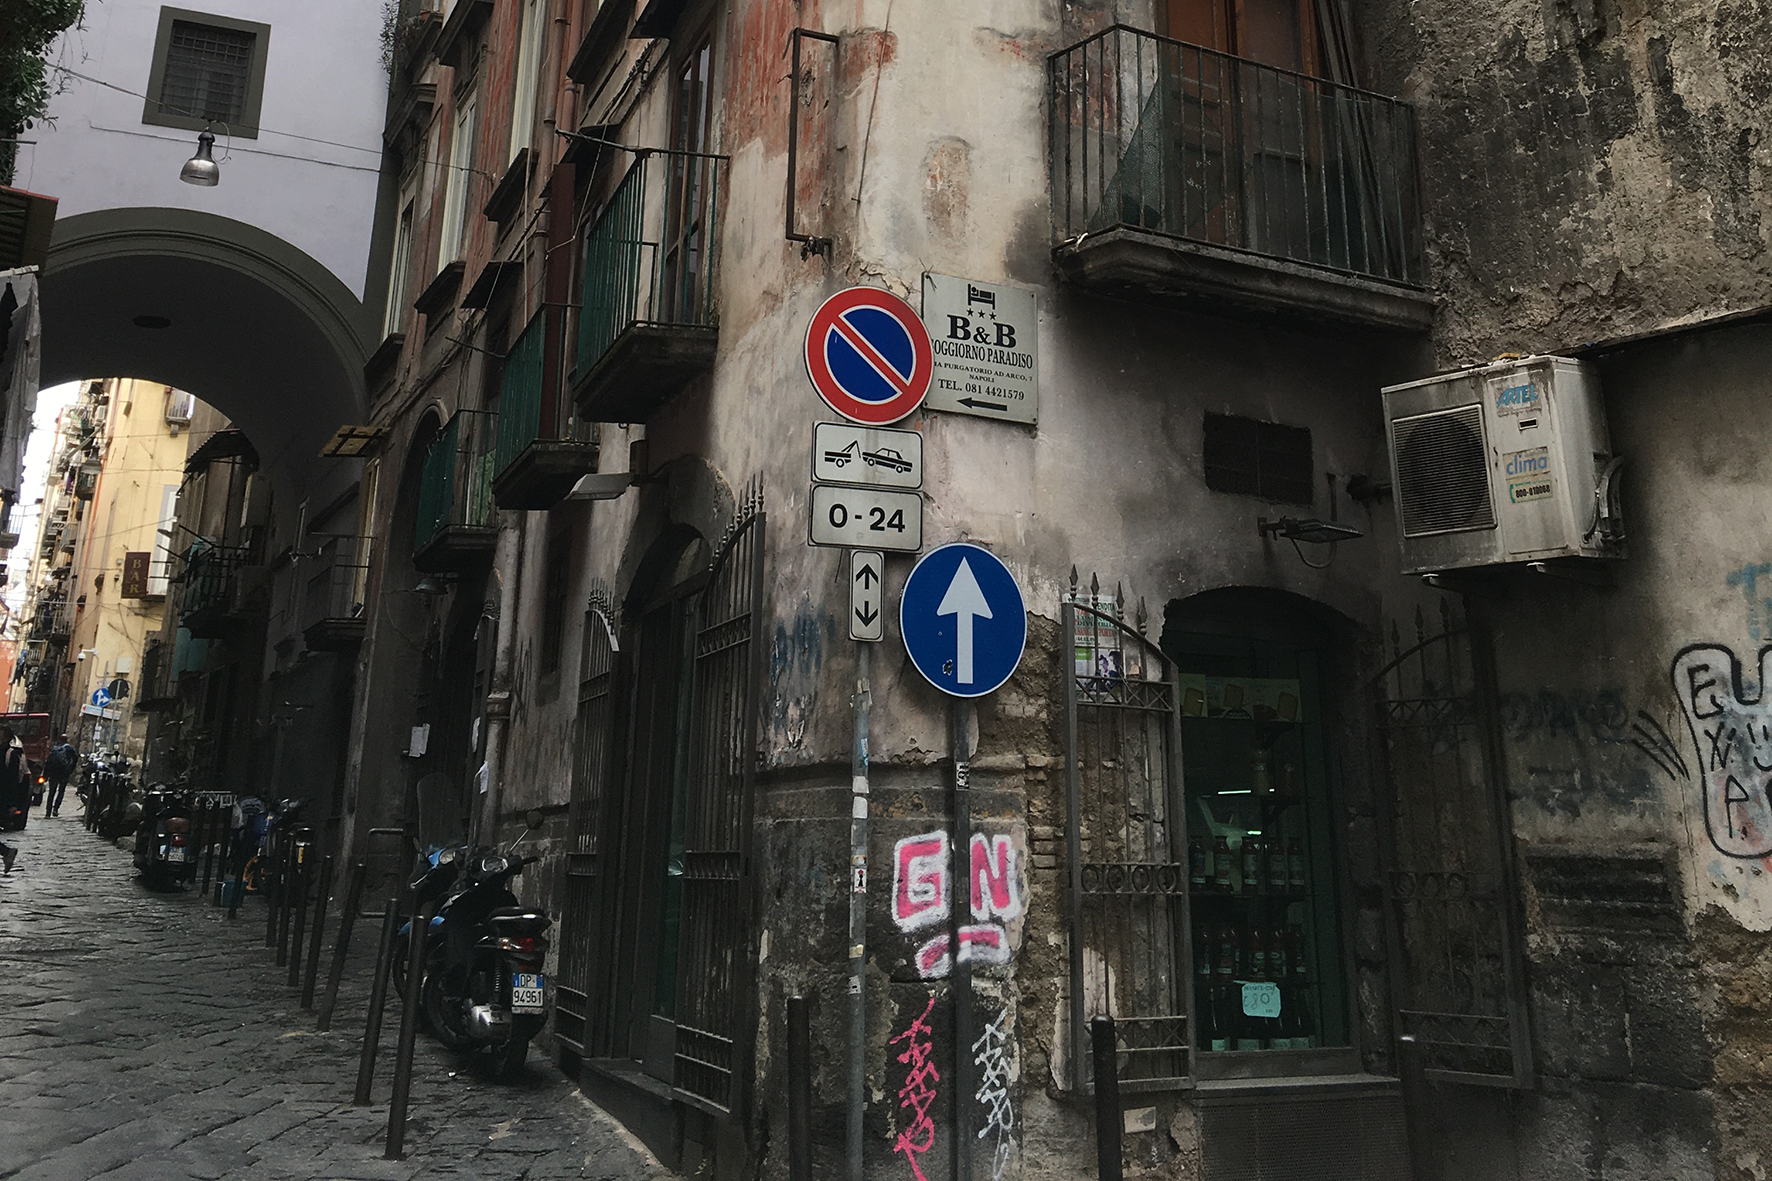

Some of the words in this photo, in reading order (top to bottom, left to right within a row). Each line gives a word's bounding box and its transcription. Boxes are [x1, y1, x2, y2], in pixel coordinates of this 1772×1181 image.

[947, 314, 1016, 348] B&B
[931, 339, 985, 361] OGGIORNO
[988, 348, 1033, 369] PARADISO
[944, 362, 992, 375] PURGATORIO
[994, 369, 1004, 377] AD
[969, 374, 995, 383] NAPOLI
[938, 379, 962, 391] TEL.
[965, 383, 982, 394] 081
[985, 386, 1024, 401] 4421579
[1506, 454, 1548, 476] clima
[130, 559, 142, 594] BAR
[520, 974, 532, 987] DP
[514, 990, 542, 1004] 94961
